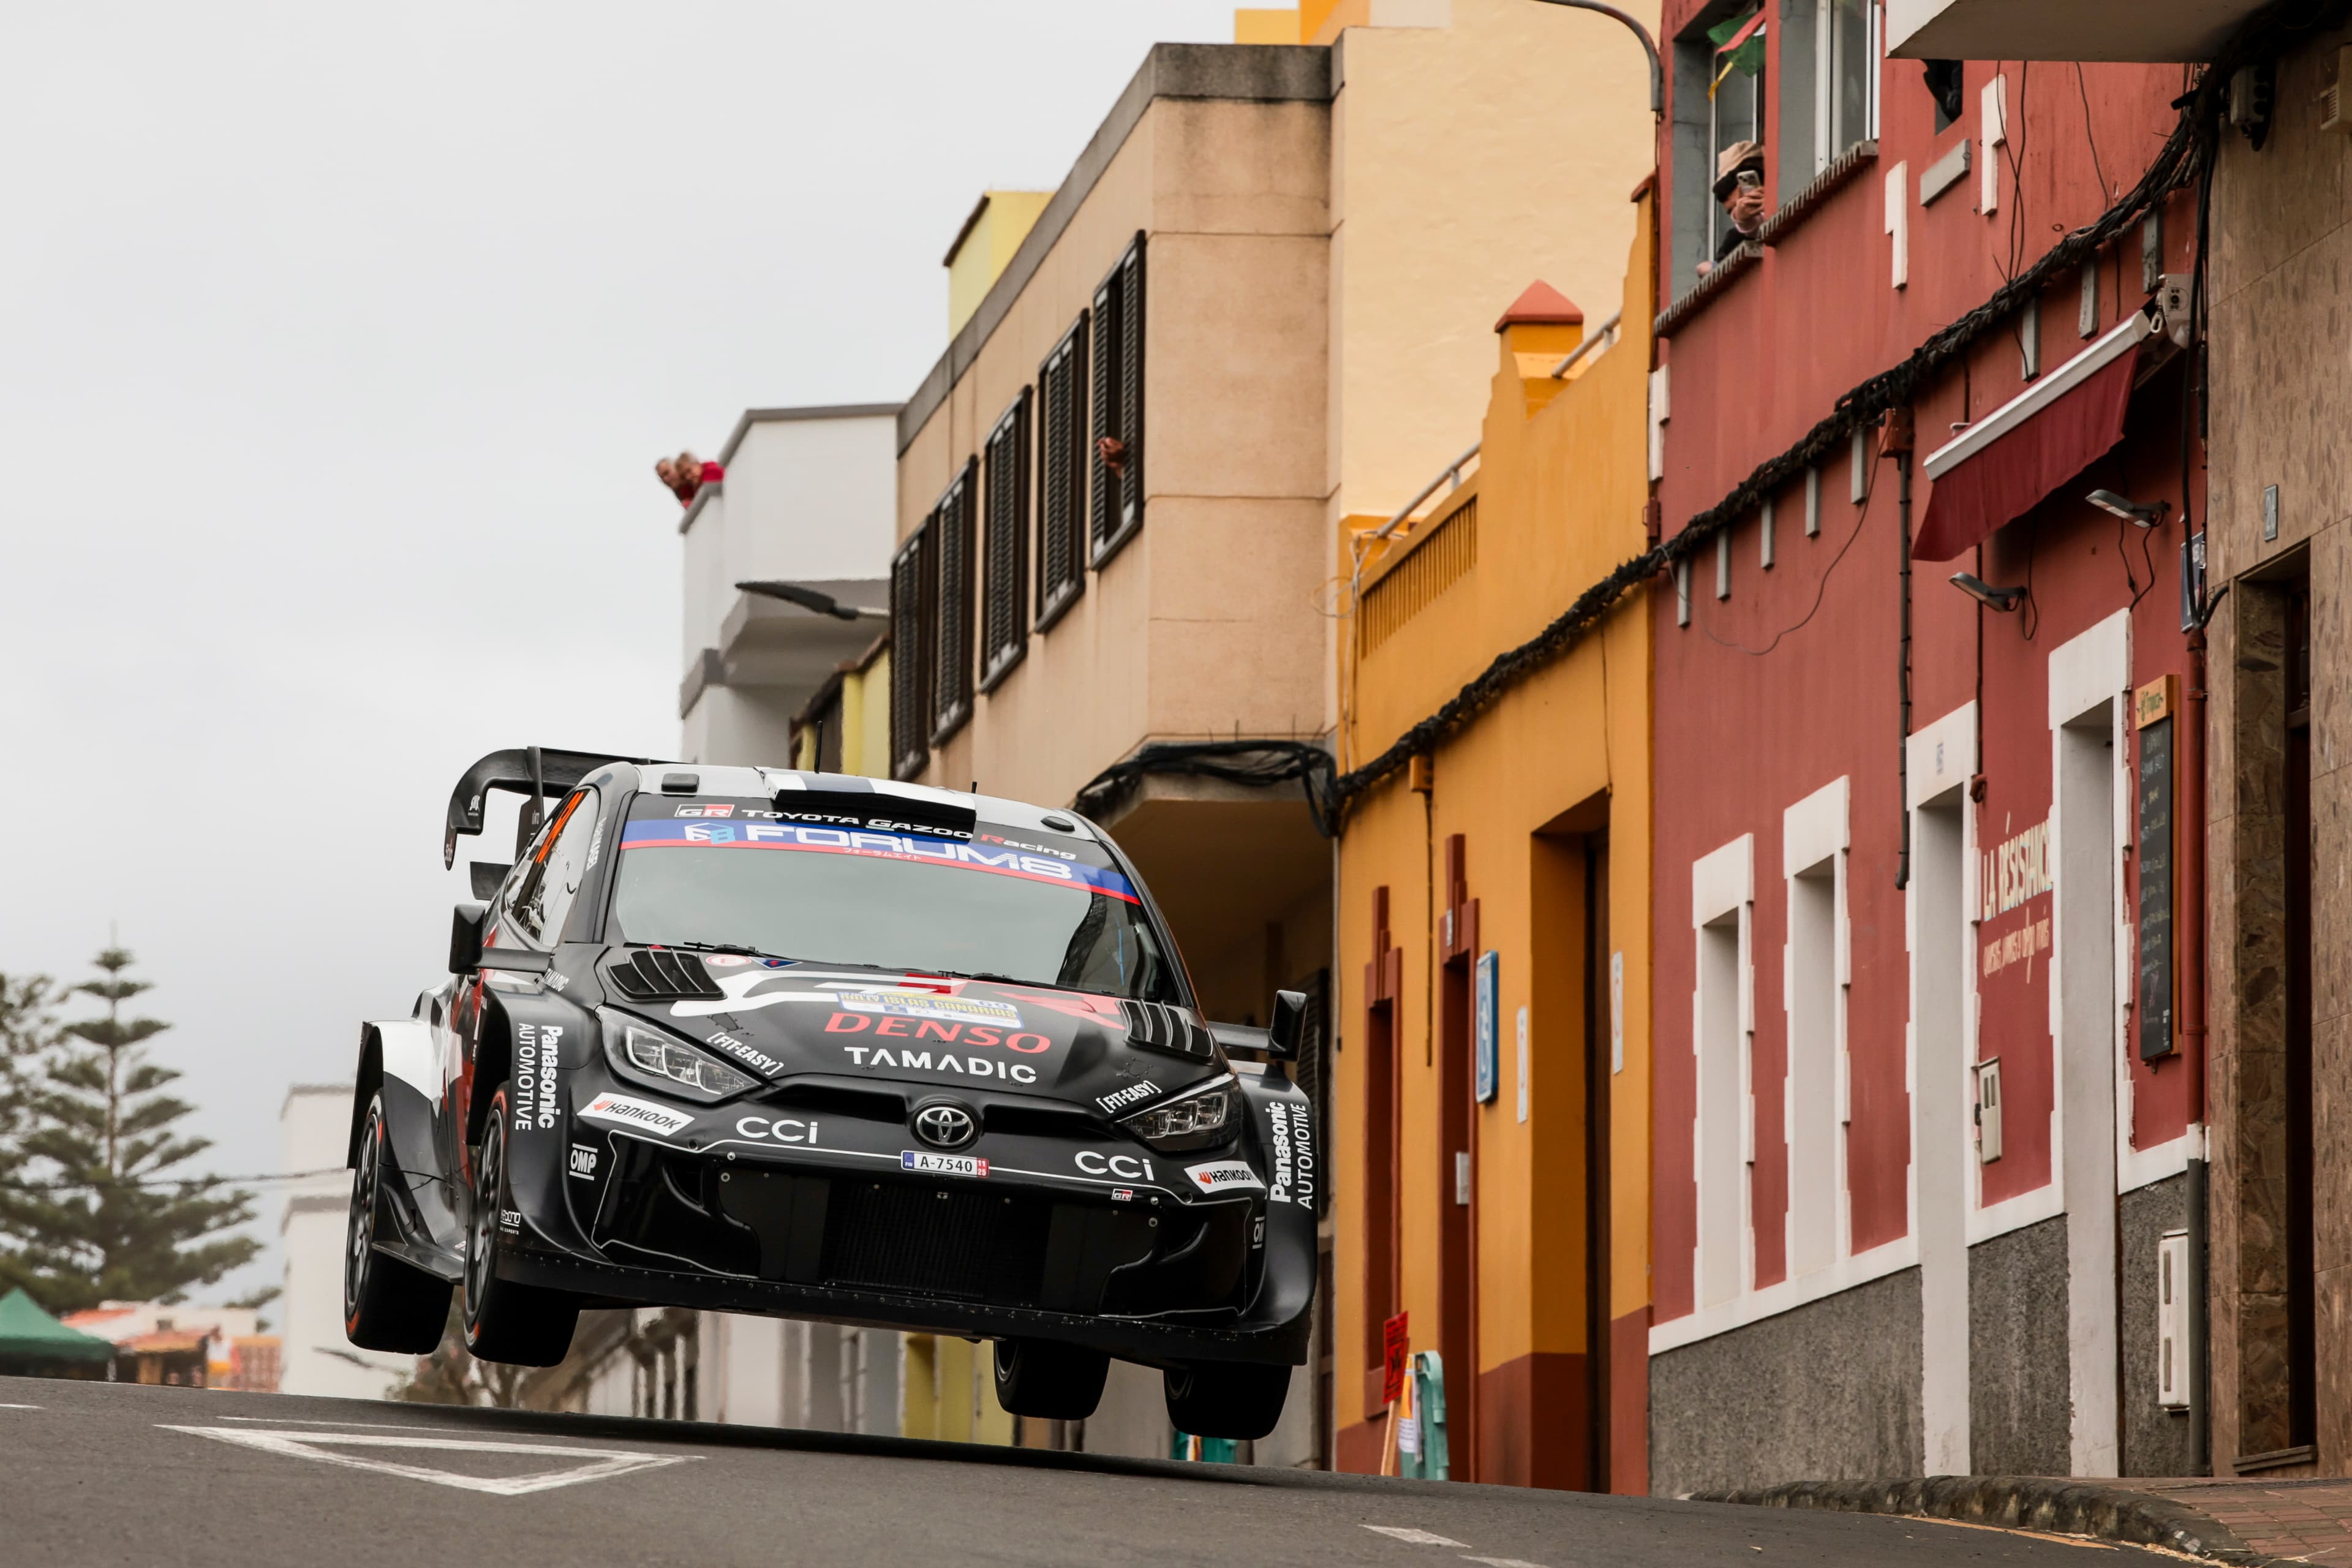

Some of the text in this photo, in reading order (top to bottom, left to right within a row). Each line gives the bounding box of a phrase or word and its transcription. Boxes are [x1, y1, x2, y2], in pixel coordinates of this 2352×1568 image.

[678, 809, 1076, 861] GR TOYOTA GAZOO Racing
[746, 824, 1073, 879] FORUM8
[842, 847, 922, 861] フォーラムエイト
[1984, 849, 1996, 921] LA
[541, 968, 570, 992] TAMADIC
[883, 995, 929, 1008] ISLAS
[934, 1000, 1017, 1018] CANARIAS
[824, 1012, 1052, 1054] DENSO
[515, 1022, 535, 1131] AUTOMOTIVE
[538, 1025, 563, 1130] Panasonic
[844, 1046, 1037, 1084] TAMADIC
[570, 1149, 597, 1174] OMP
[920, 1156, 973, 1172] A-7540
[1265, 1101, 1291, 1204] Panasonic
[1290, 1102, 1313, 1210] AUTOMOTIVE
